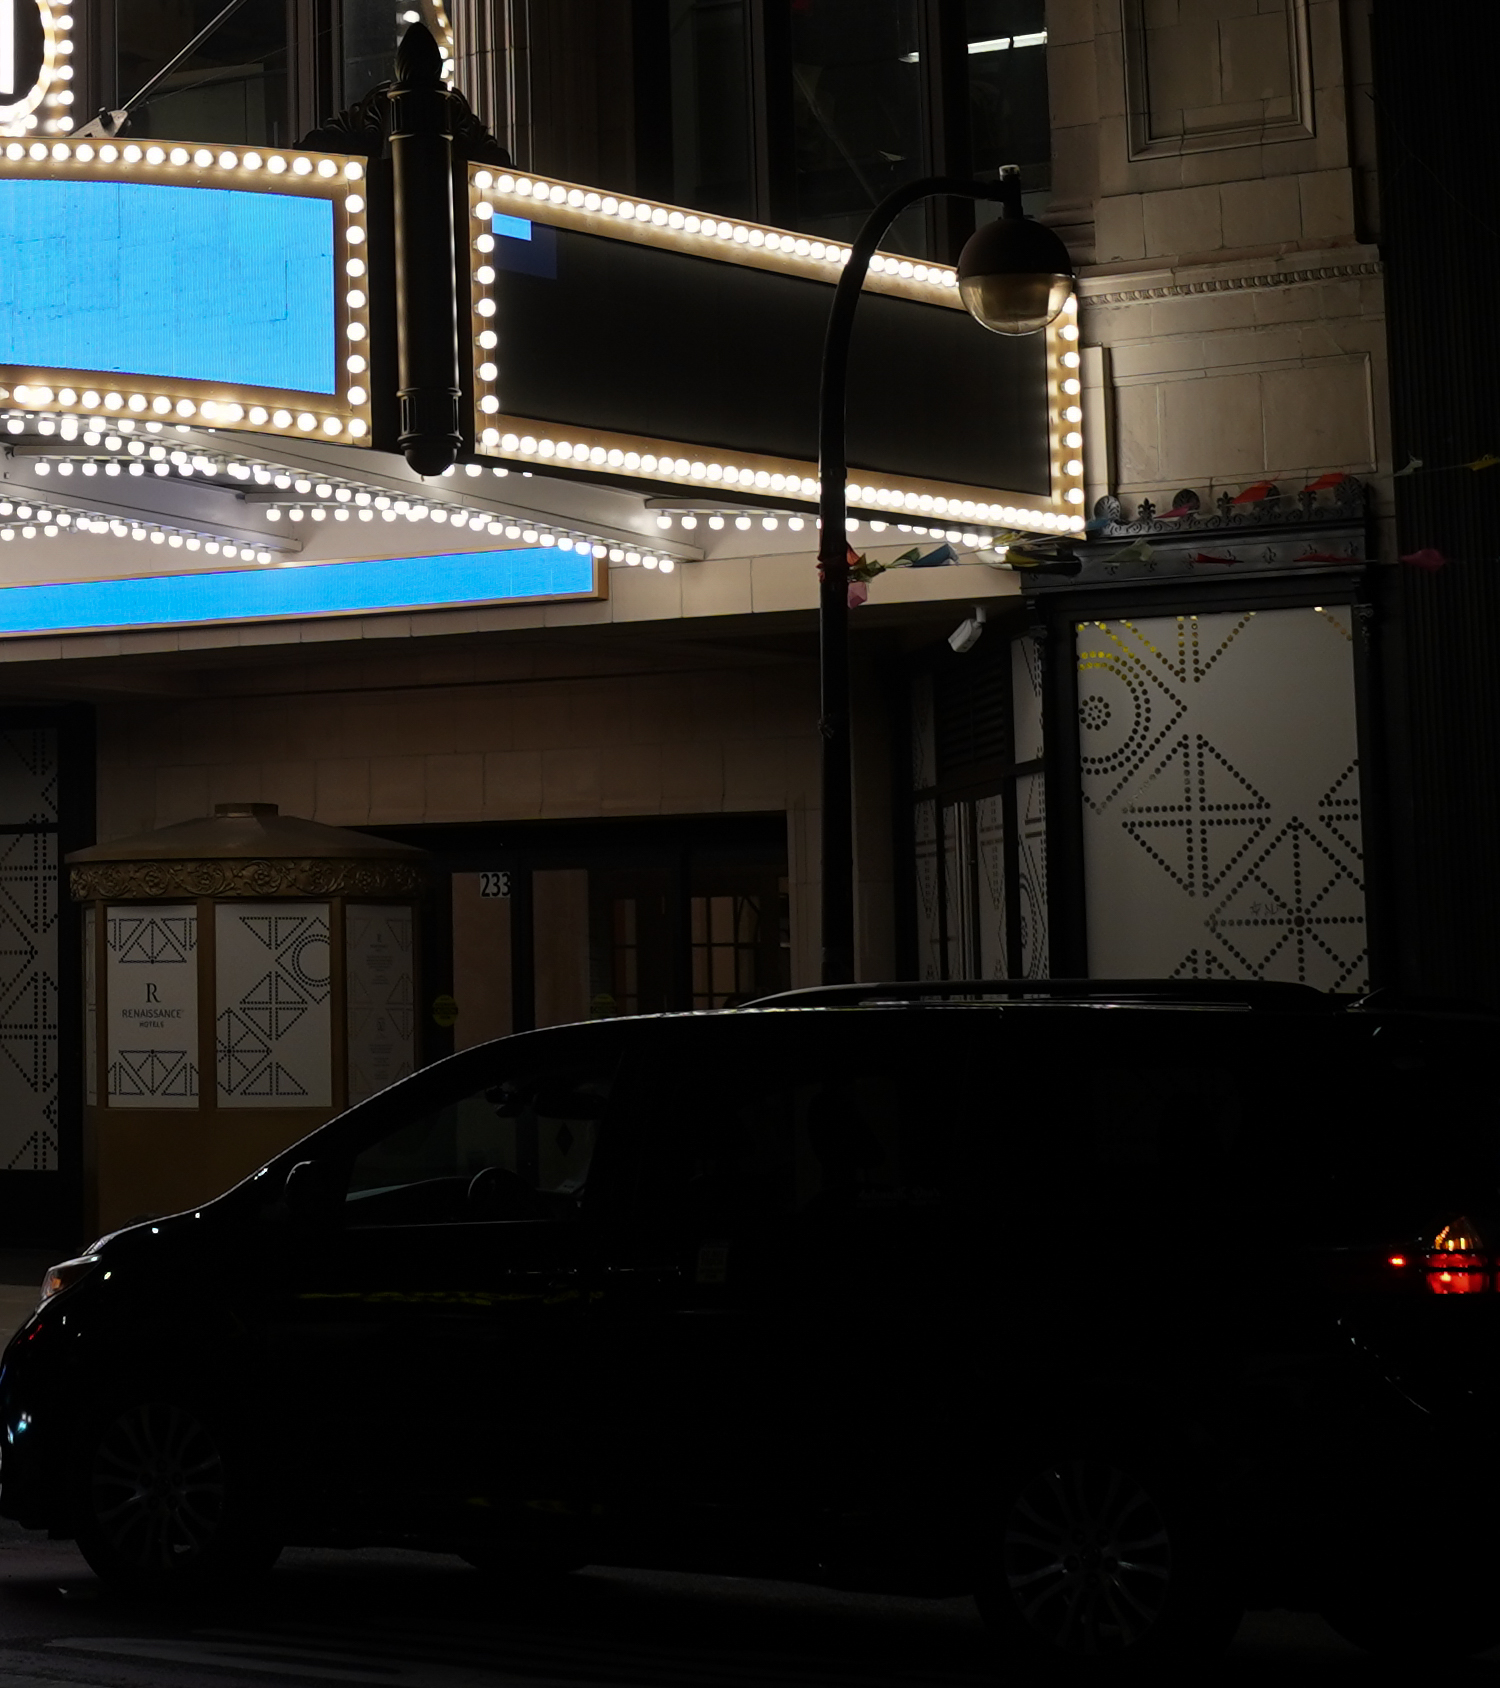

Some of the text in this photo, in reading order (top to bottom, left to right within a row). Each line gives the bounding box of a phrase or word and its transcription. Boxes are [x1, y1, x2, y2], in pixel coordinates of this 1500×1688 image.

[481, 872, 511, 898] 233
[145, 982, 162, 1003] R
[121, 1009, 183, 1019] RENAISSANCE
